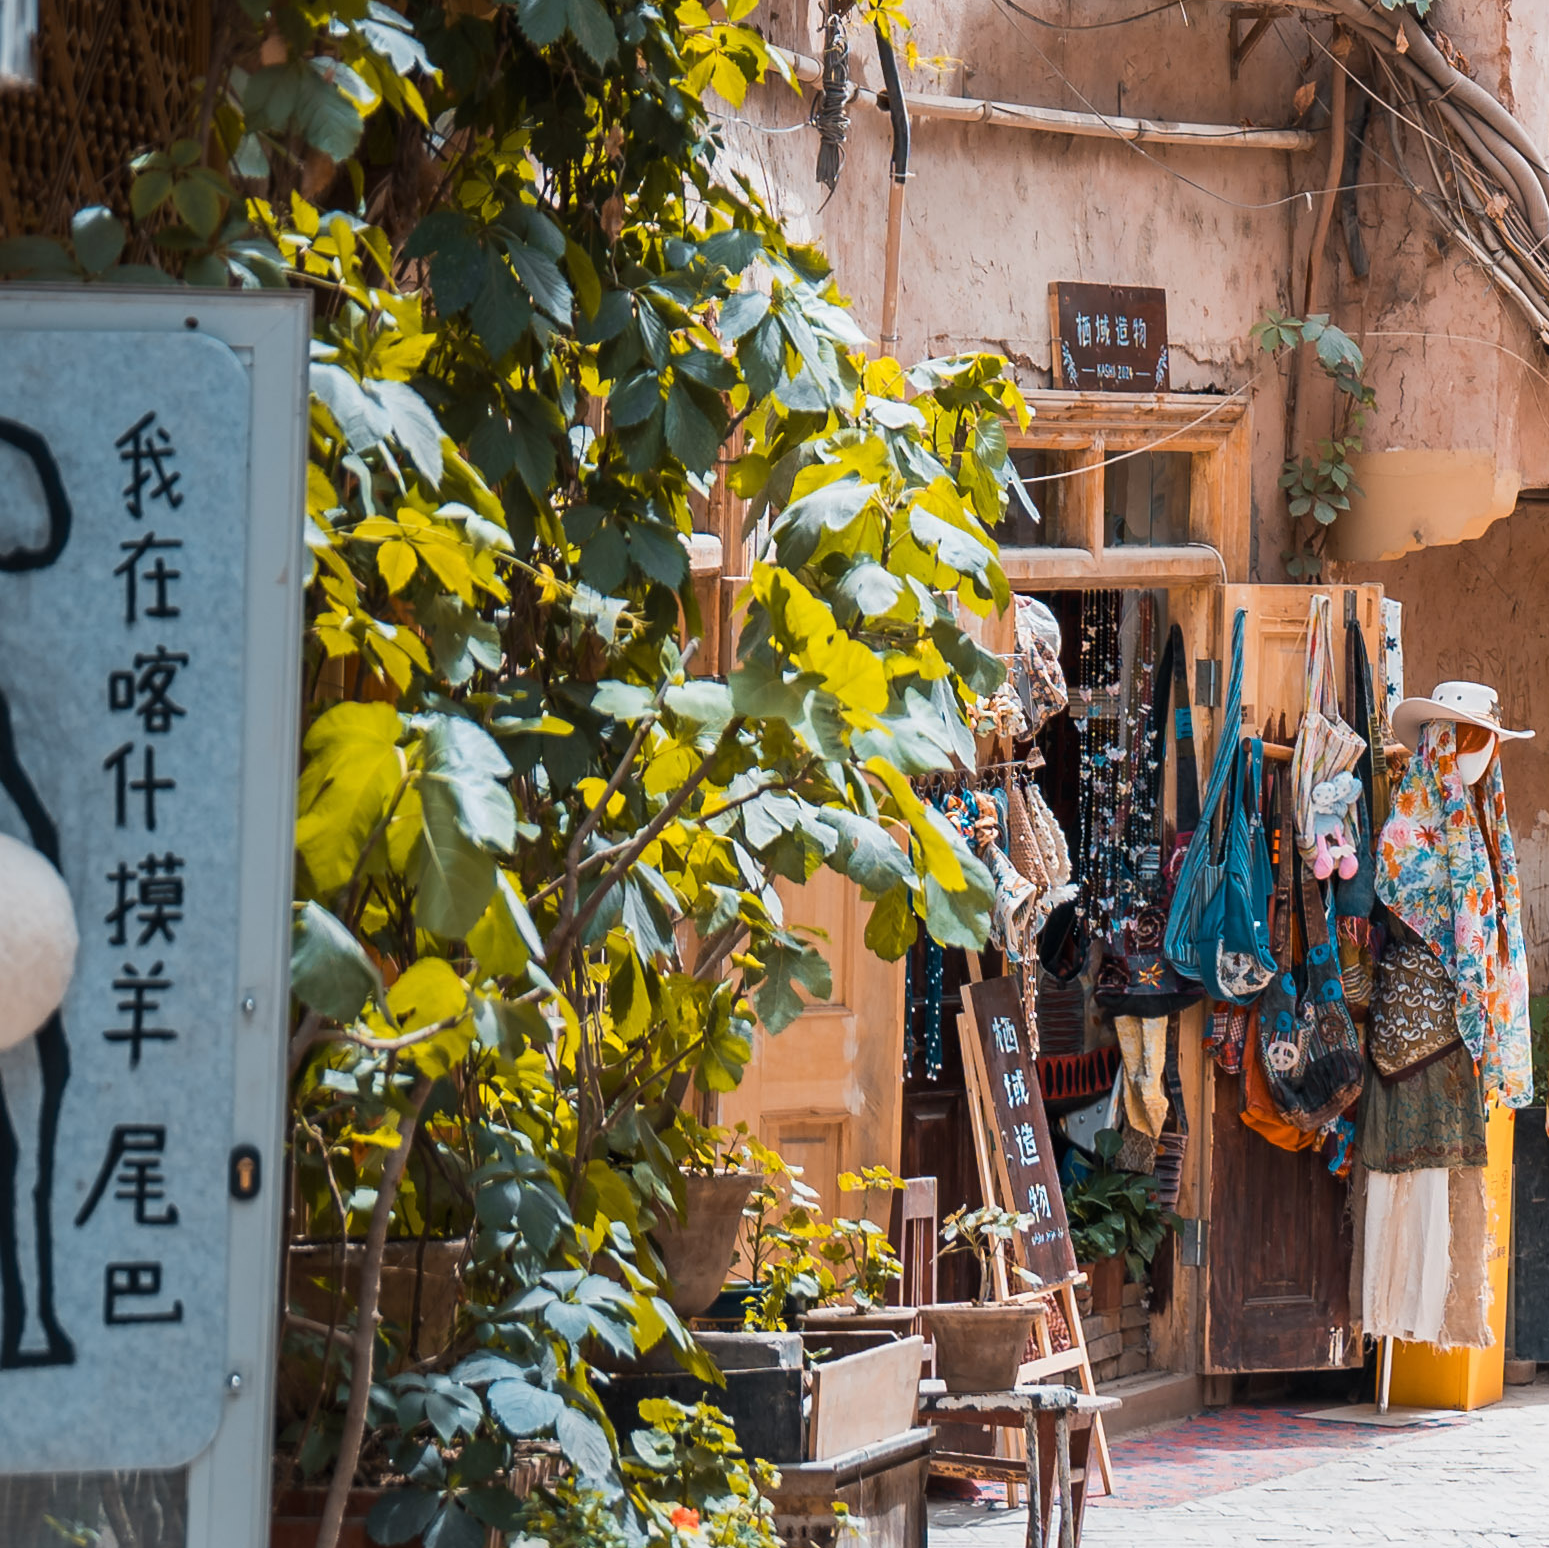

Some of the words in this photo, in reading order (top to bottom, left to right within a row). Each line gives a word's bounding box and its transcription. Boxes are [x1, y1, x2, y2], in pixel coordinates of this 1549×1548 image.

[1075, 311, 1147, 350] 栖域造物
[74, 409, 189, 1328] 我在喀什摸羊尾巴
[991, 1015, 1052, 1223] 栖域造物
